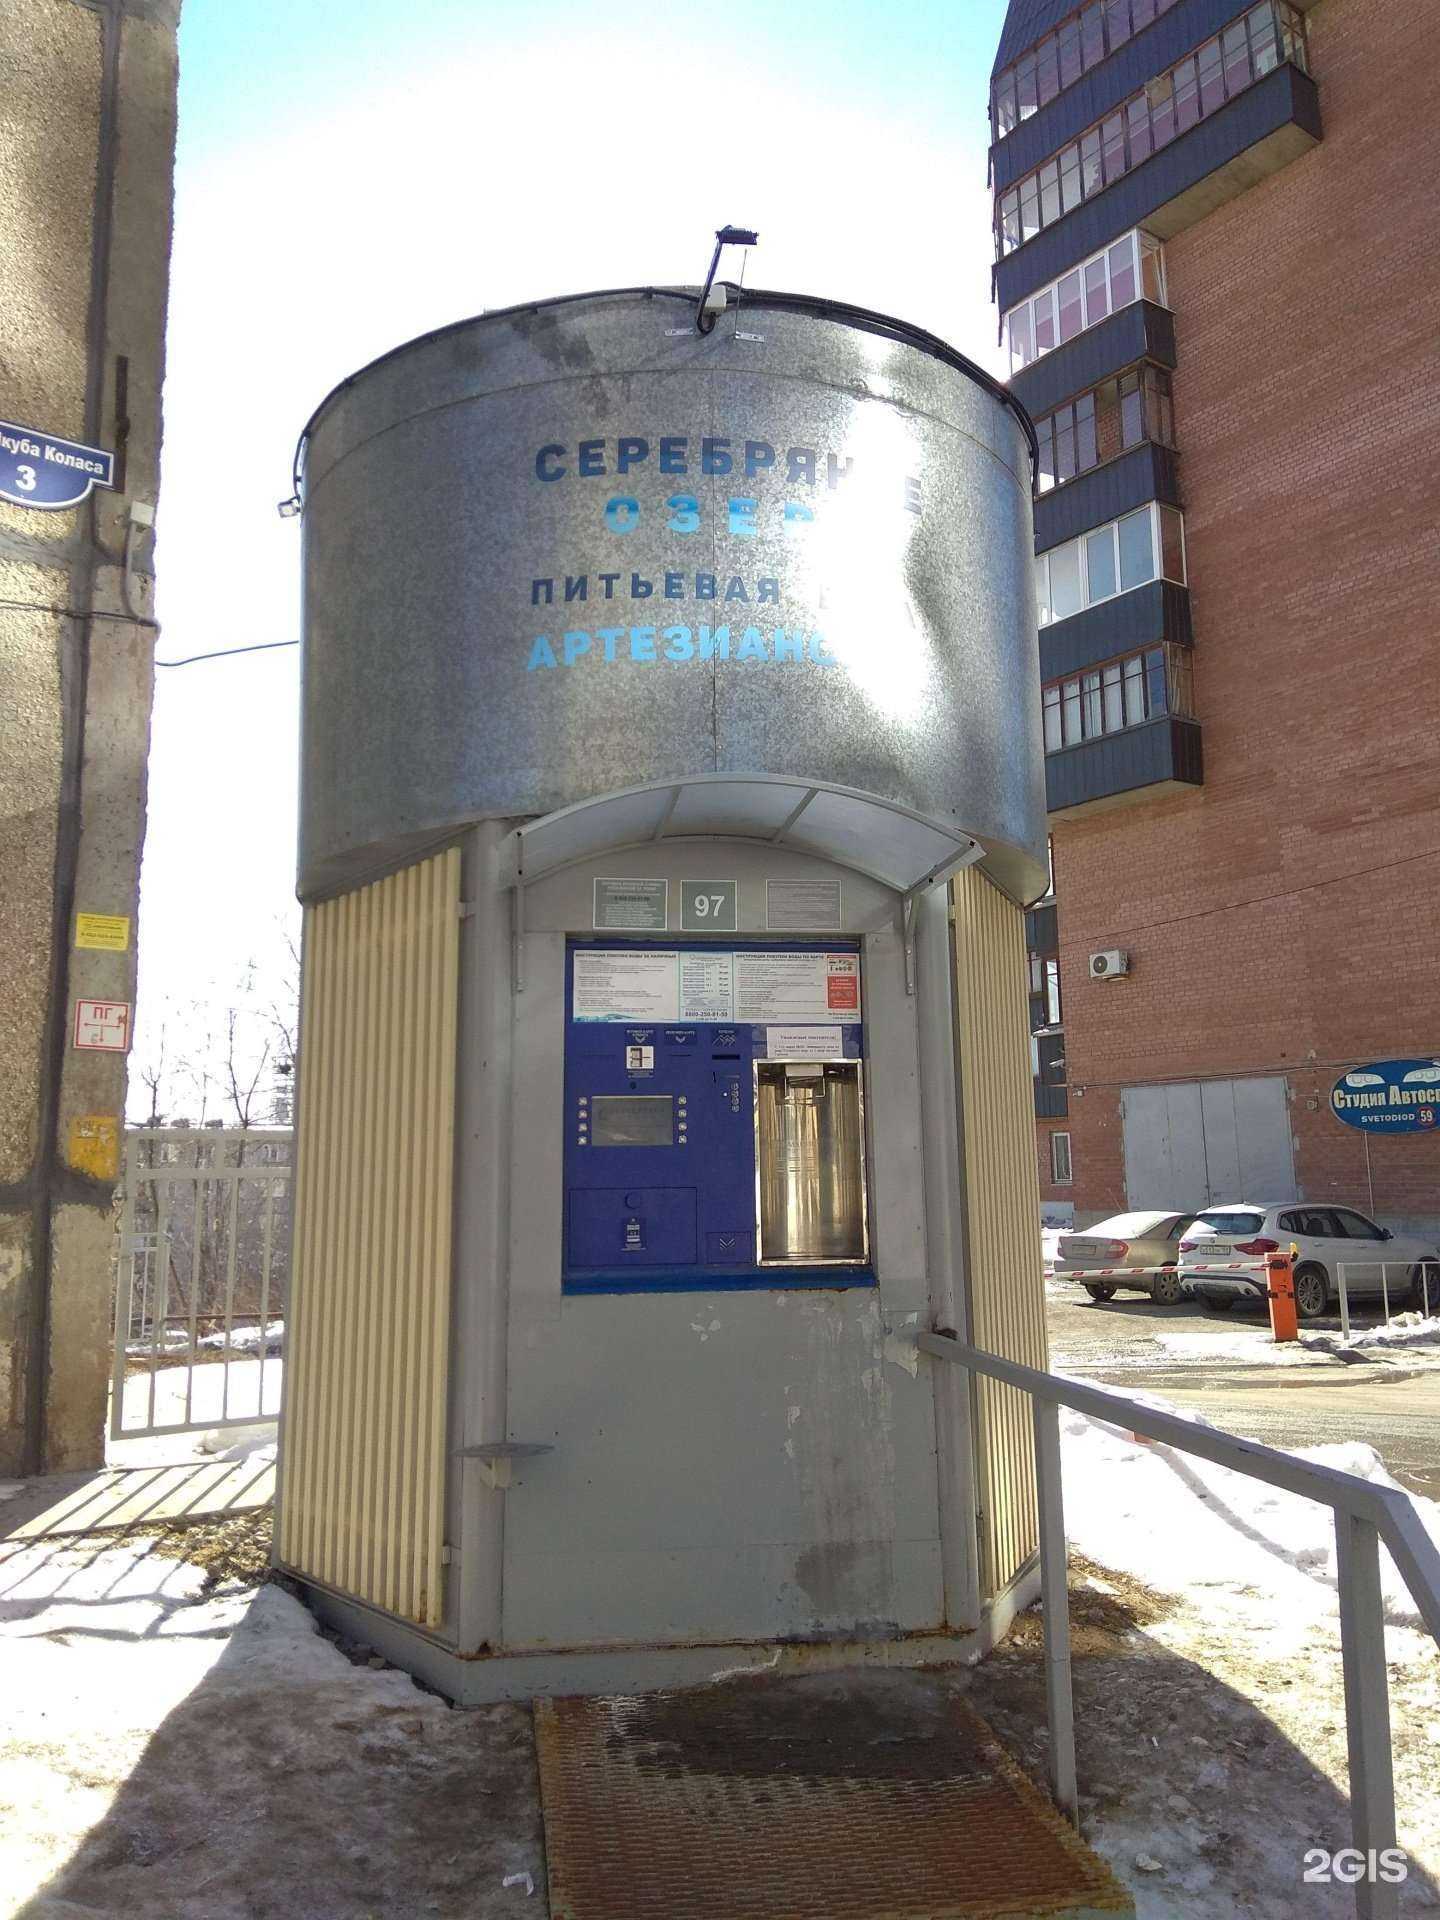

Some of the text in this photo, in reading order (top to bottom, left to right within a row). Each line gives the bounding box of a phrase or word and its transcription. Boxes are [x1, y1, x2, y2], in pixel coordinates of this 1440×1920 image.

[0, 432, 104, 474] куба Коласа
[15, 464, 36, 491] 3
[535, 437, 922, 517] СЕРЕБРЯНЕ
[603, 494, 815, 537] ОЗЕР
[531, 572, 780, 605] ПИТЬЕВАЯ
[527, 624, 838, 672] АРТЕЗИАНС
[693, 894, 725, 917] 97
[94, 1006, 113, 1020] ПГ
[1361, 1110, 1433, 1123] SVETODIOD 59
